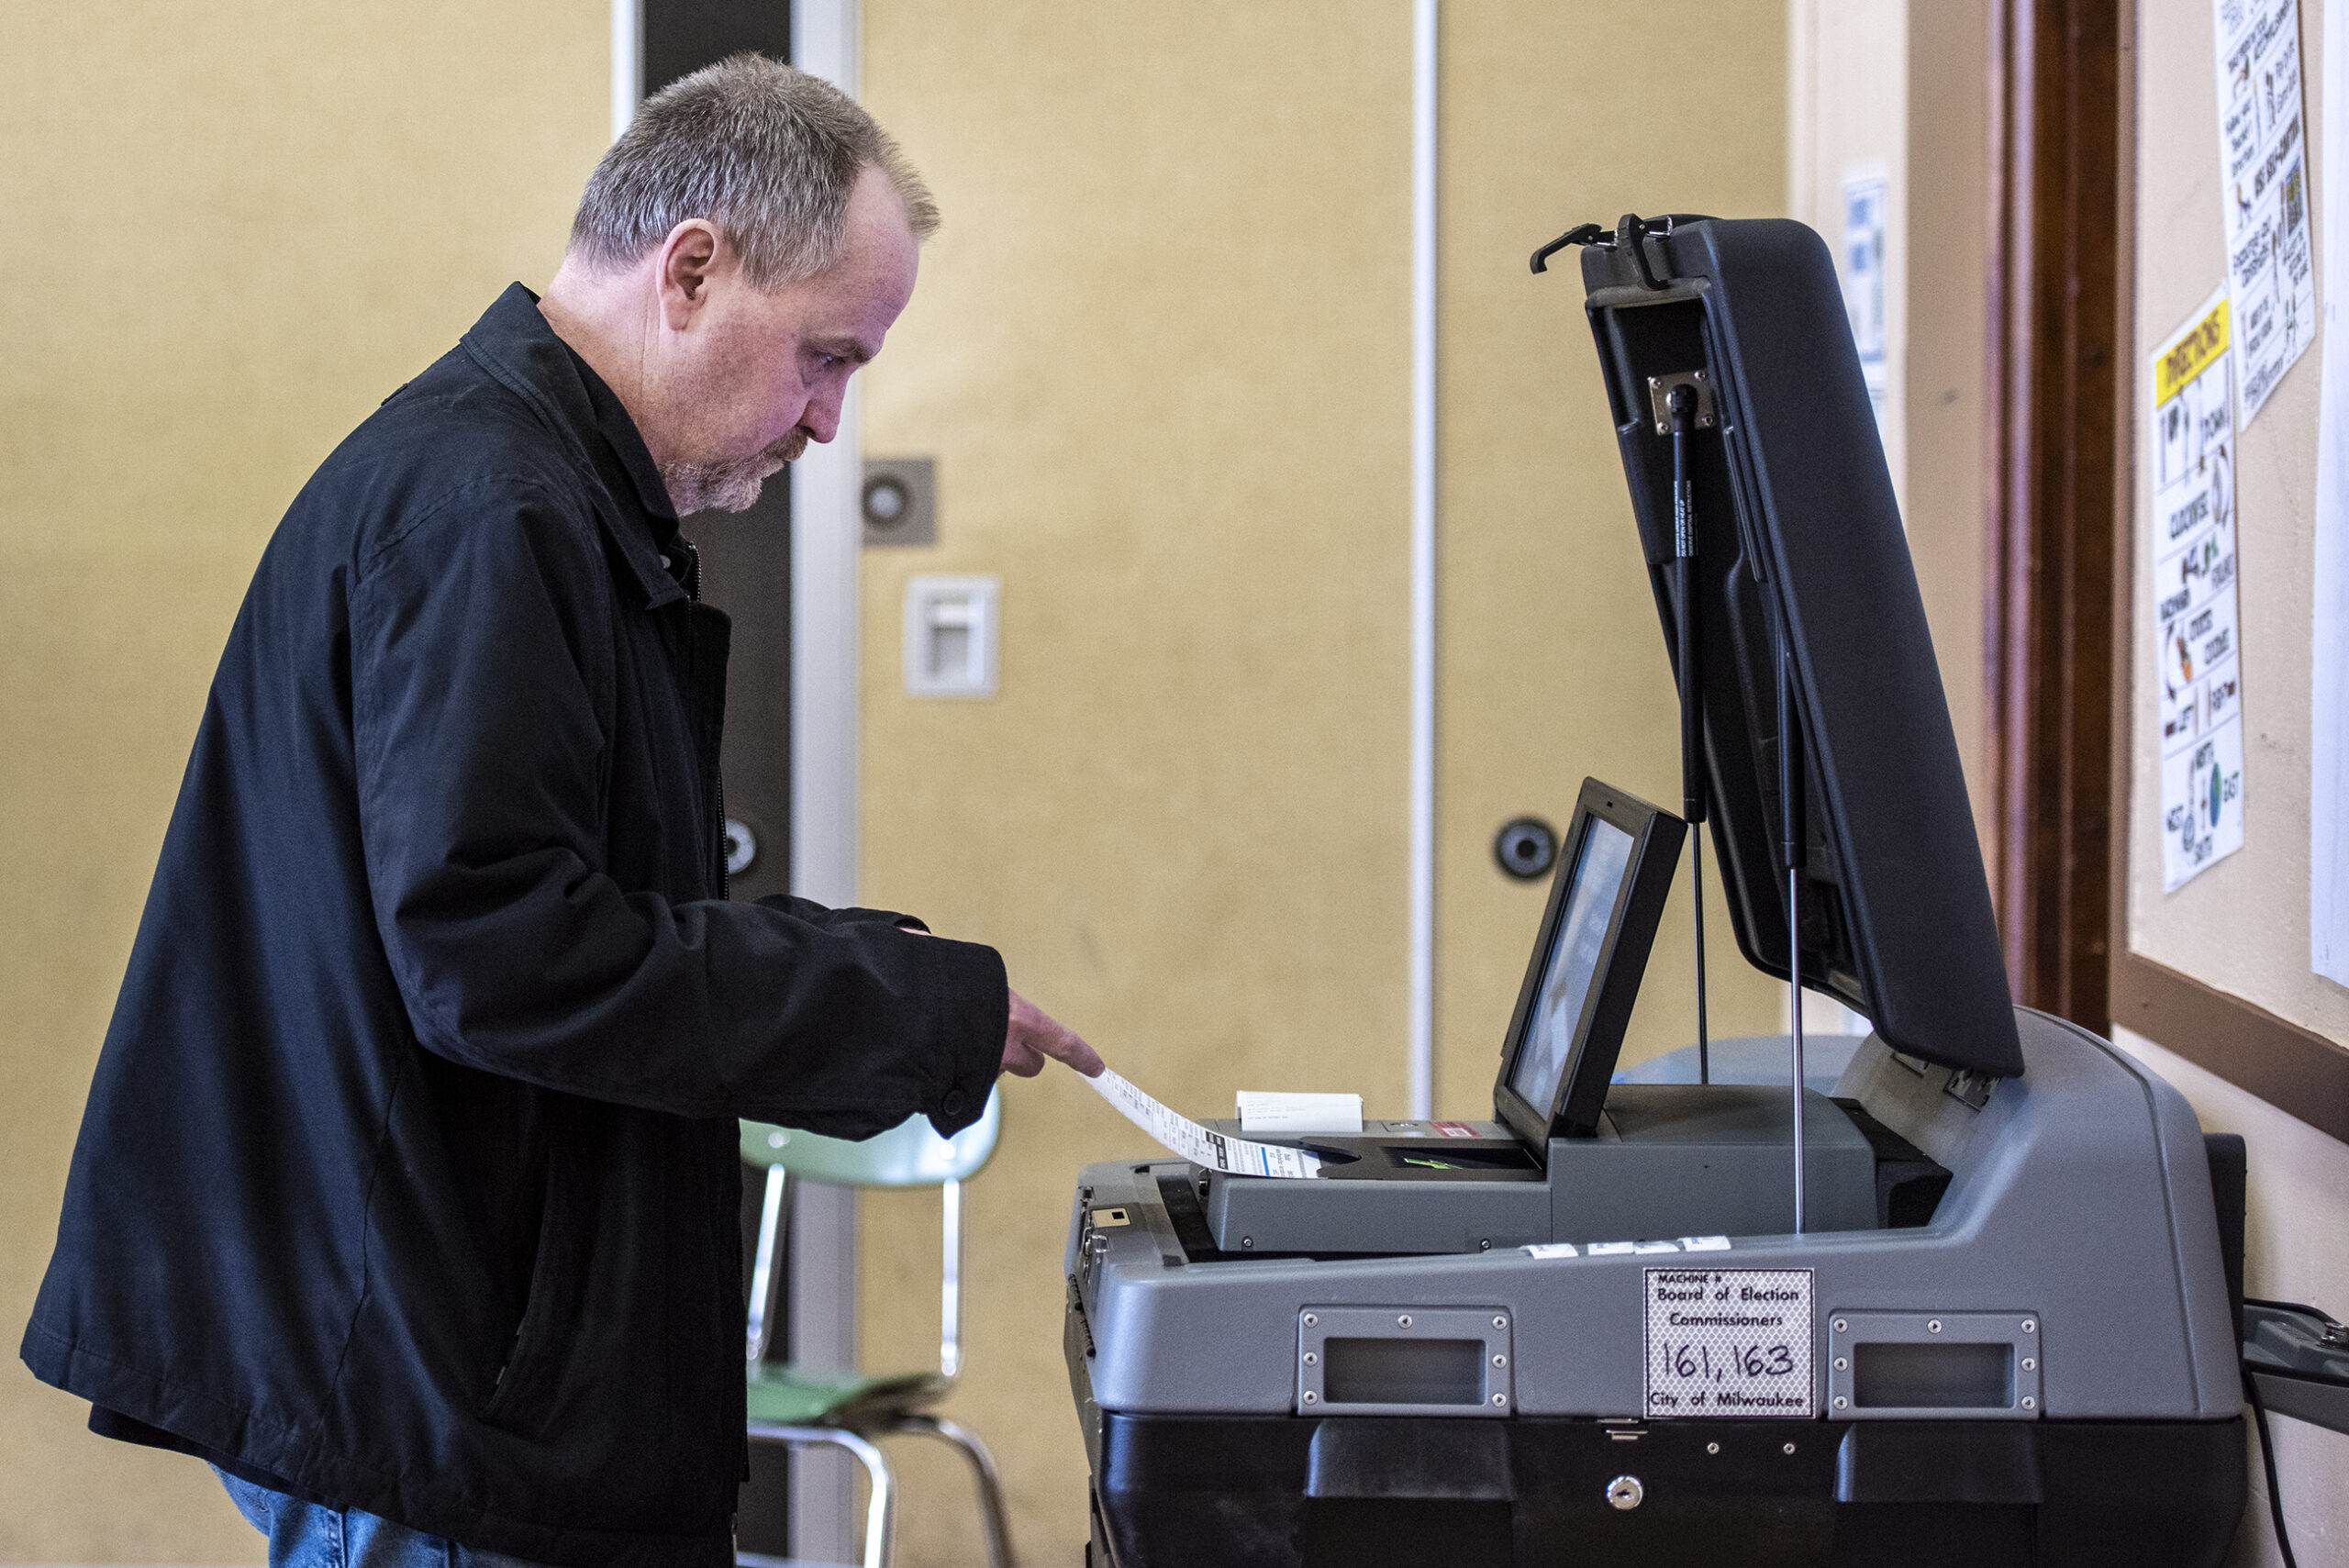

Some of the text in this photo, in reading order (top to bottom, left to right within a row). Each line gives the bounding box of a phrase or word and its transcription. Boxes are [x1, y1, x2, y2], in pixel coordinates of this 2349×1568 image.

[1658, 1274, 1722, 1284] MACHINE #
[1657, 1287, 1799, 1301] Board of Election
[1669, 1312, 1783, 1327] Commissioners
[1664, 1343, 1793, 1383] 161,163
[1651, 1391, 1804, 1408] City of Milwaukee
